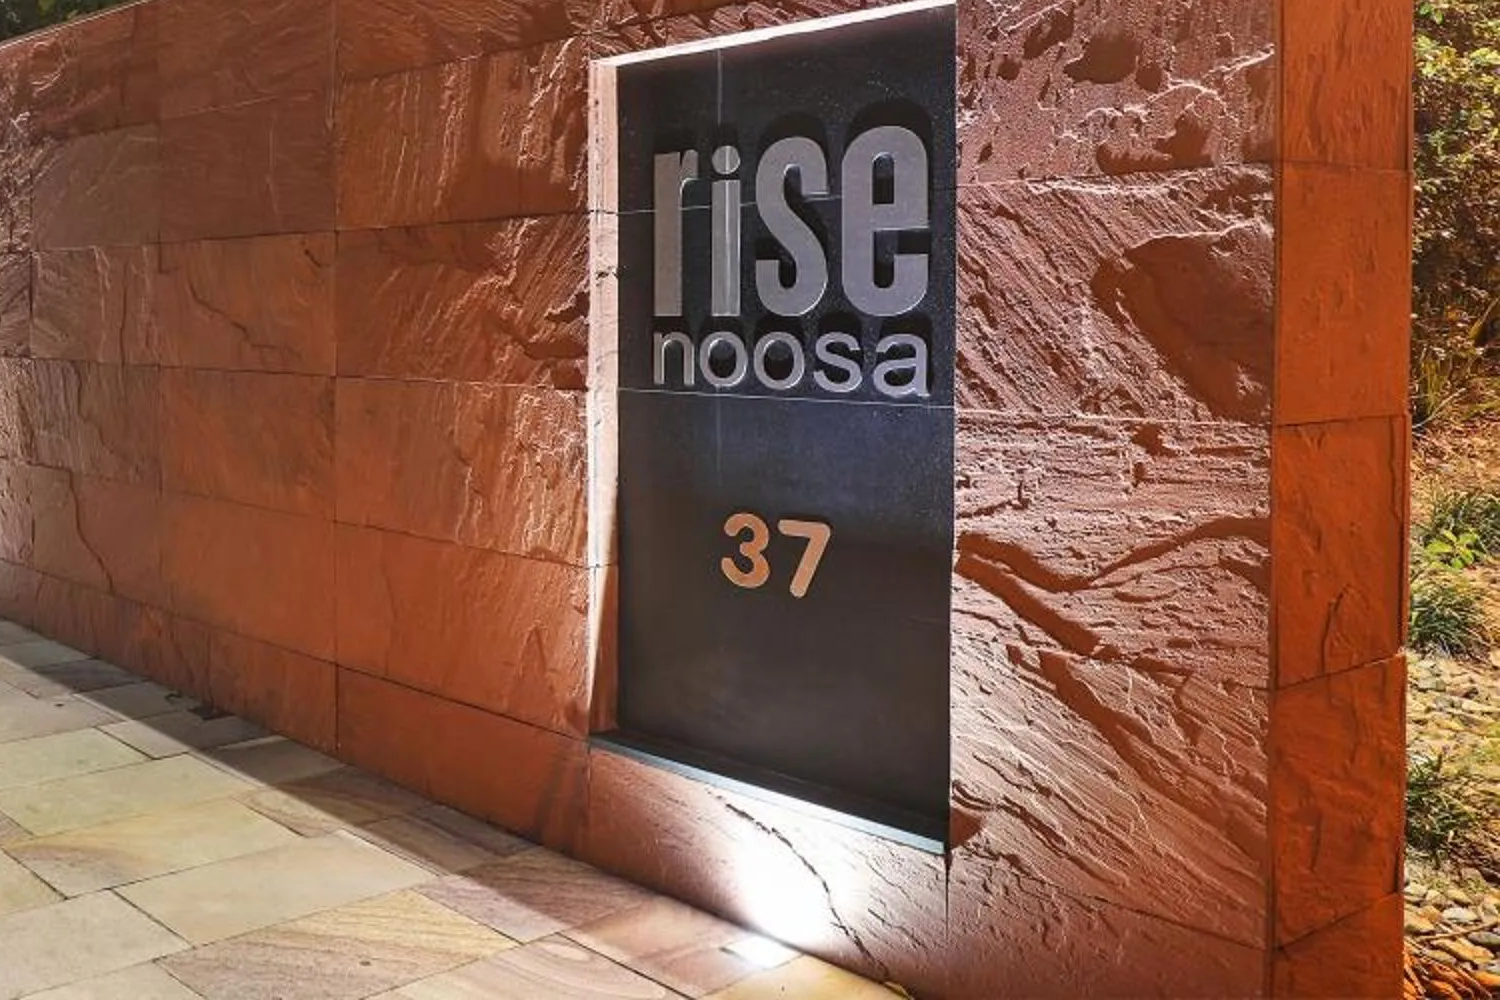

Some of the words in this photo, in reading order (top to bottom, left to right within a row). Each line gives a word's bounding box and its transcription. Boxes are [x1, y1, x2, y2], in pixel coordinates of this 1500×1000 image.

[653, 125, 930, 317] rise
[653, 330, 931, 398] noosa
[721, 512, 831, 598] 37
